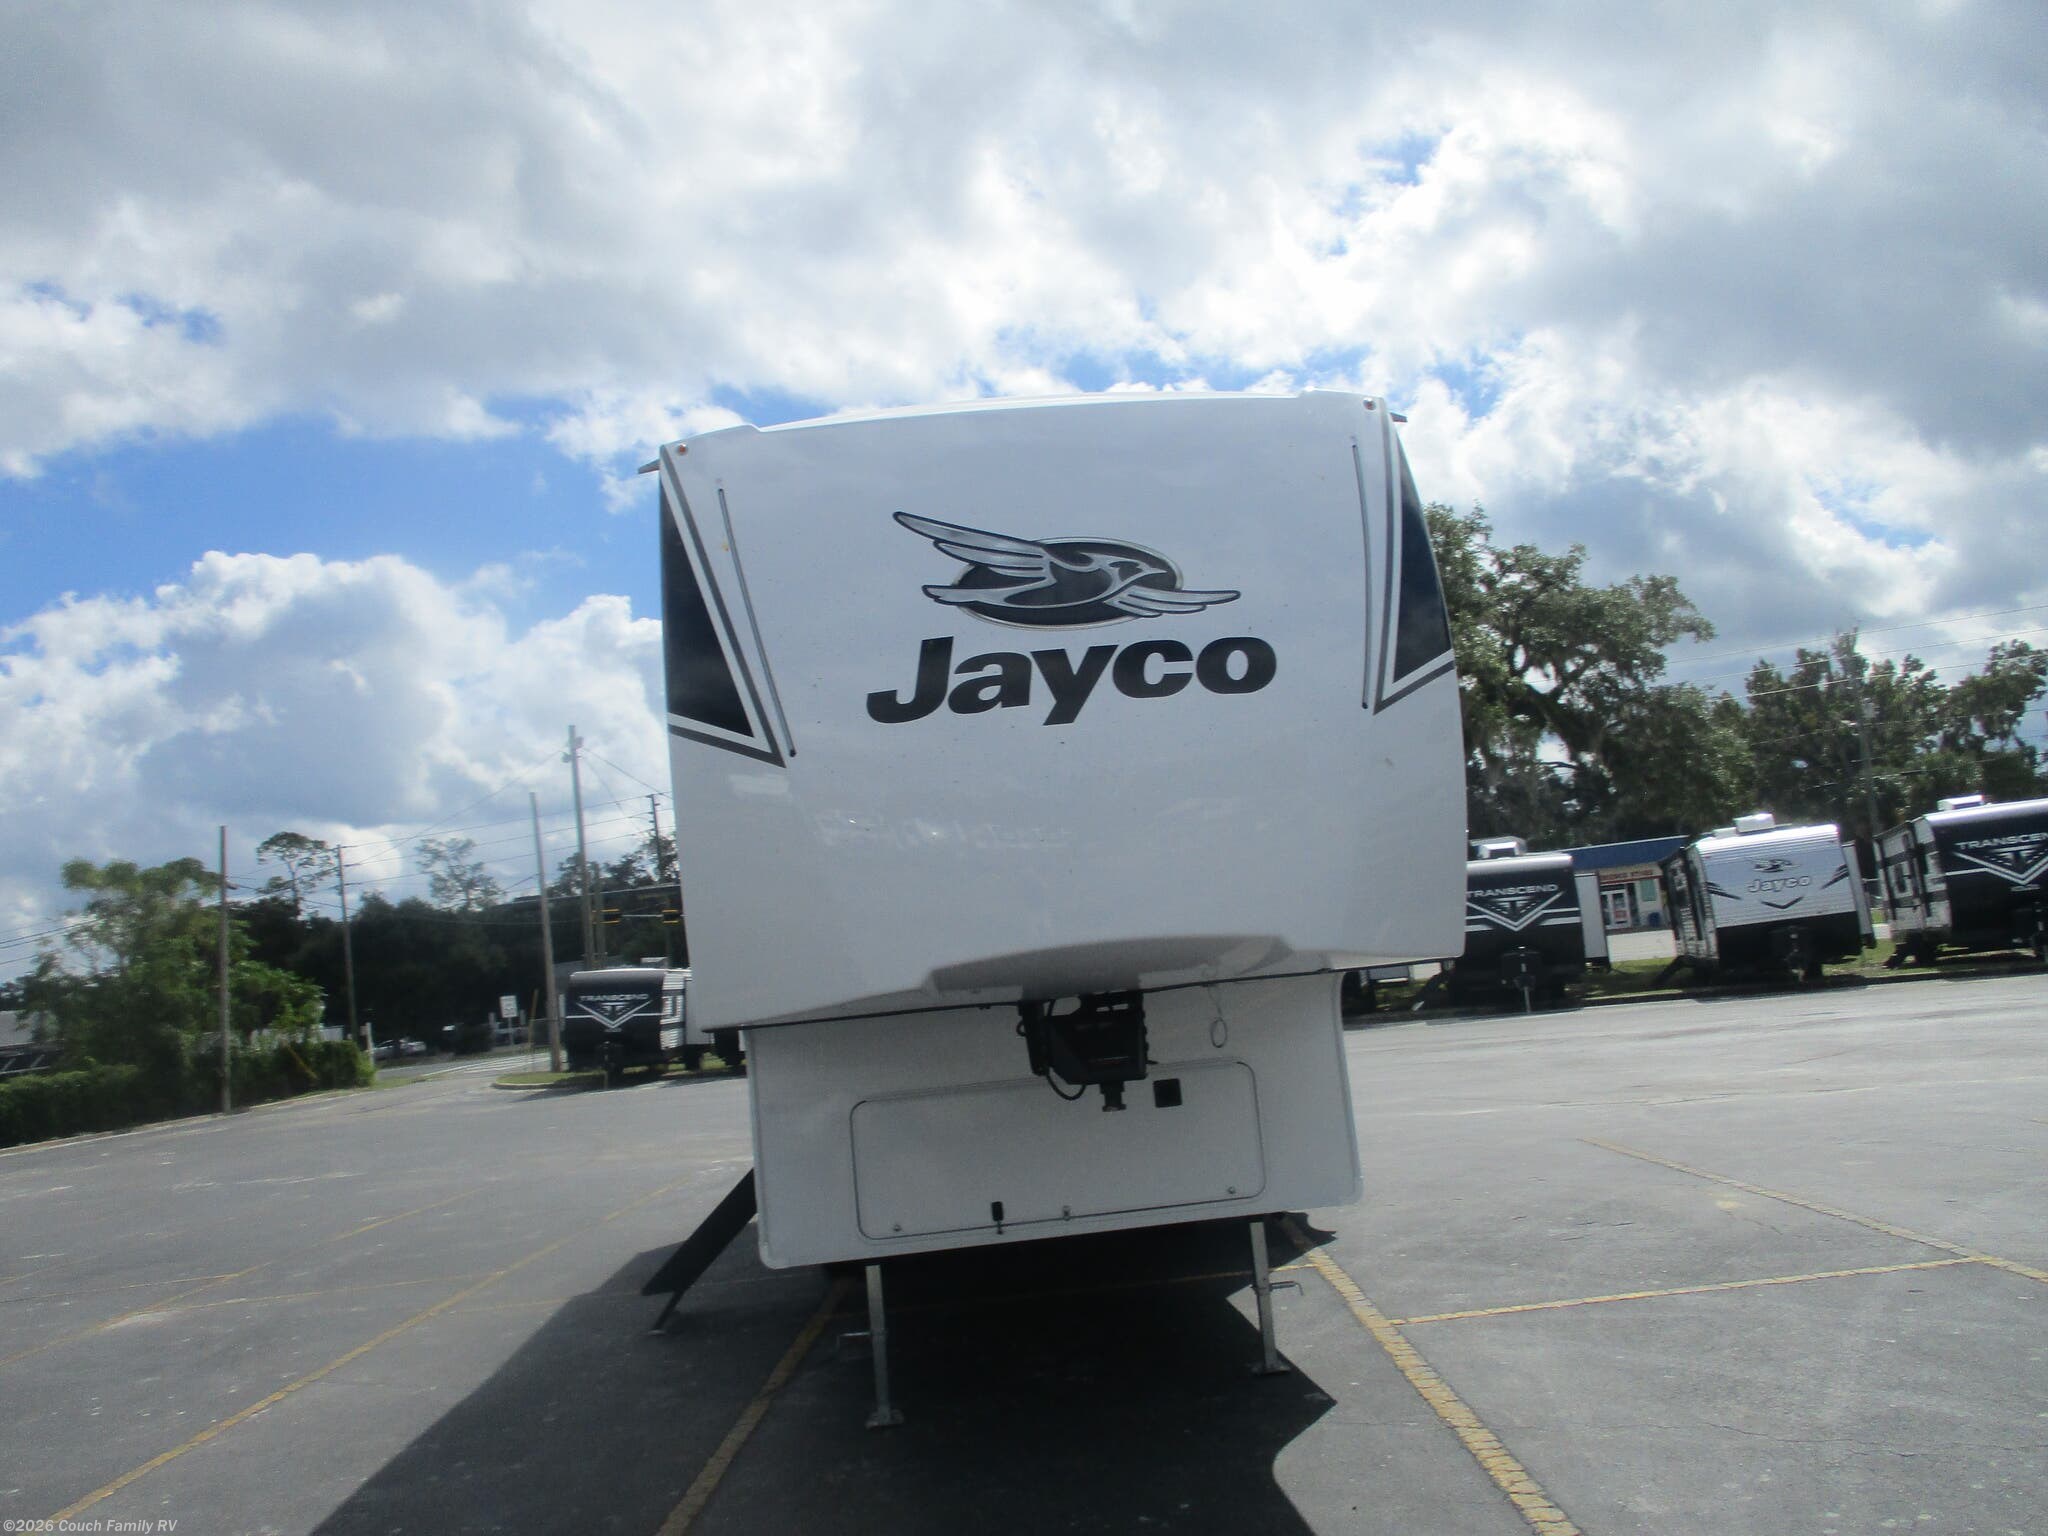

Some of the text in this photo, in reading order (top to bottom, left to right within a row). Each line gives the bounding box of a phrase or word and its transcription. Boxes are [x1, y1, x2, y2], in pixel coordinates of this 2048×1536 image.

[867, 636, 1277, 726] Jayco
[1465, 884, 1558, 898] TRANSCEND
[1748, 876, 1811, 892] Jayco
[579, 993, 649, 1001] TRANSCEND
